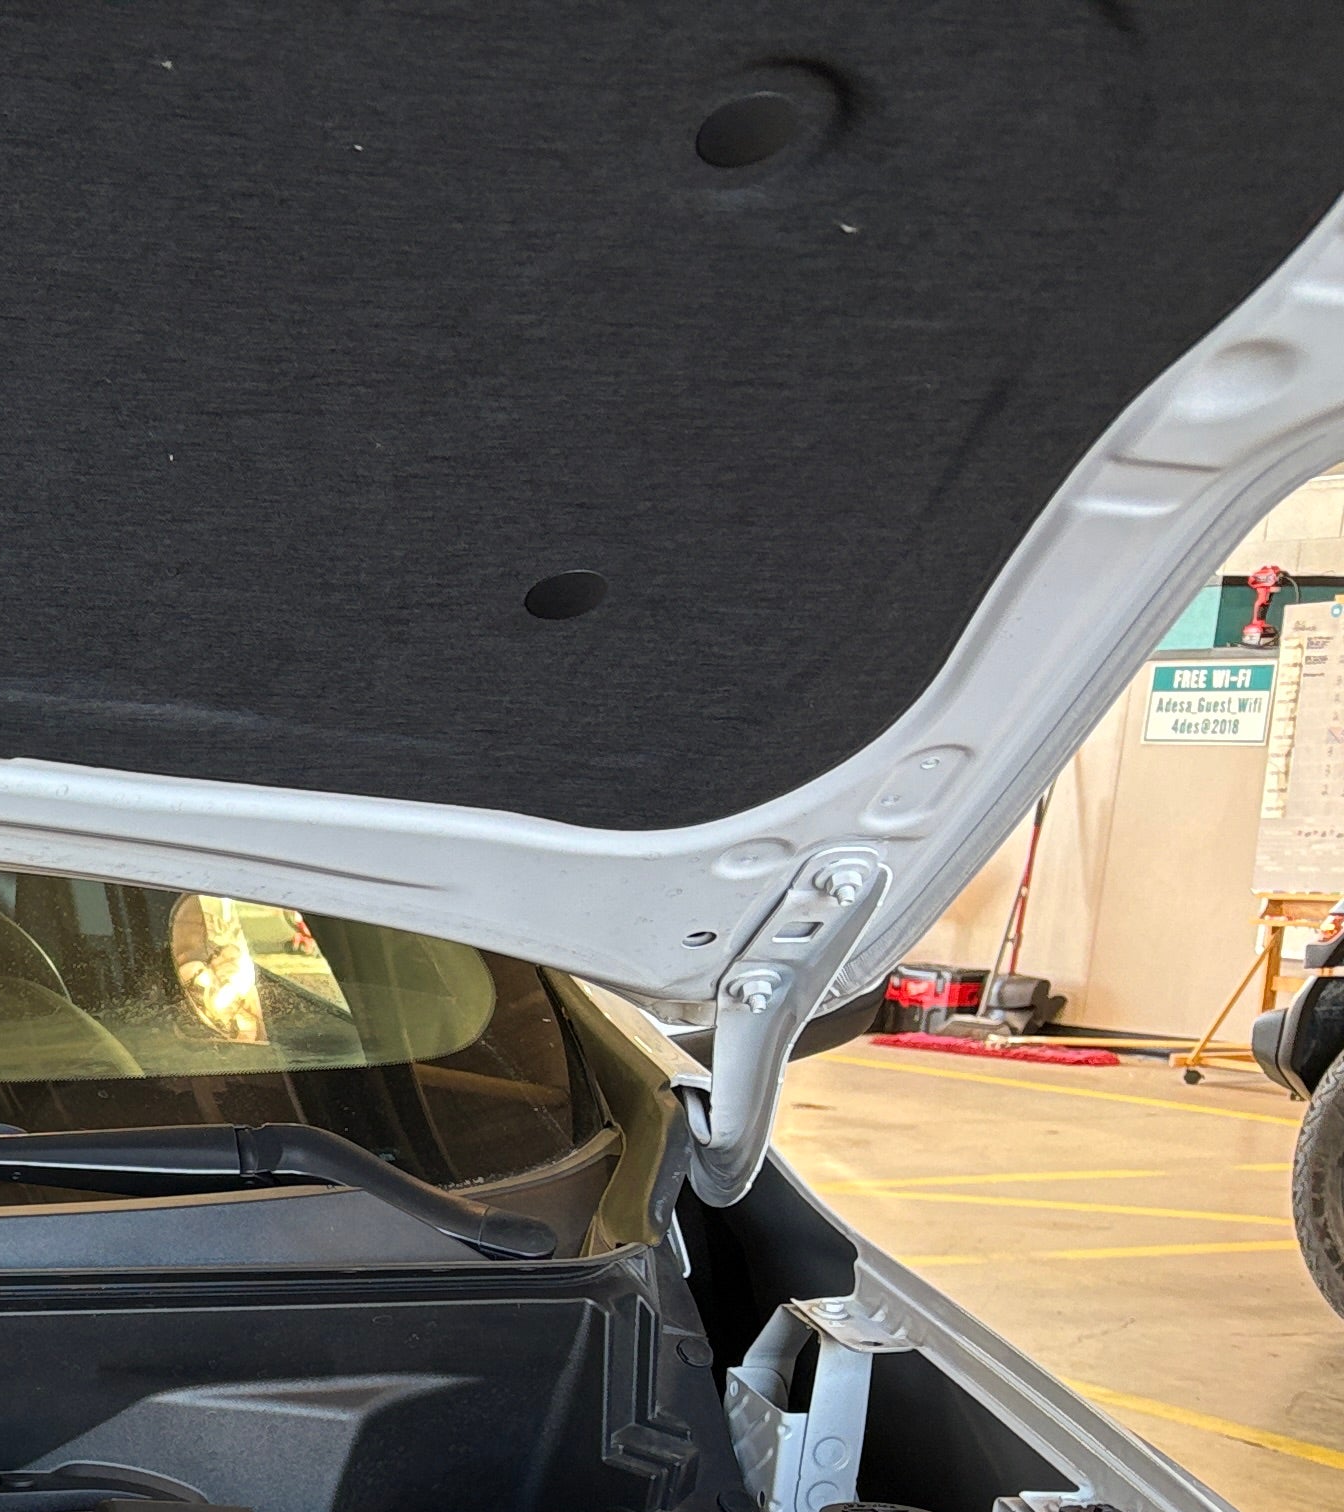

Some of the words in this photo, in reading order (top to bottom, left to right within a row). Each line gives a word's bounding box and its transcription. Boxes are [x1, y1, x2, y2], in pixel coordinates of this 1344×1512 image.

[1173, 669, 1207, 689] FREE
[1212, 668, 1252, 689] WI-FI
[1171, 718, 1240, 735] 4des@2018
